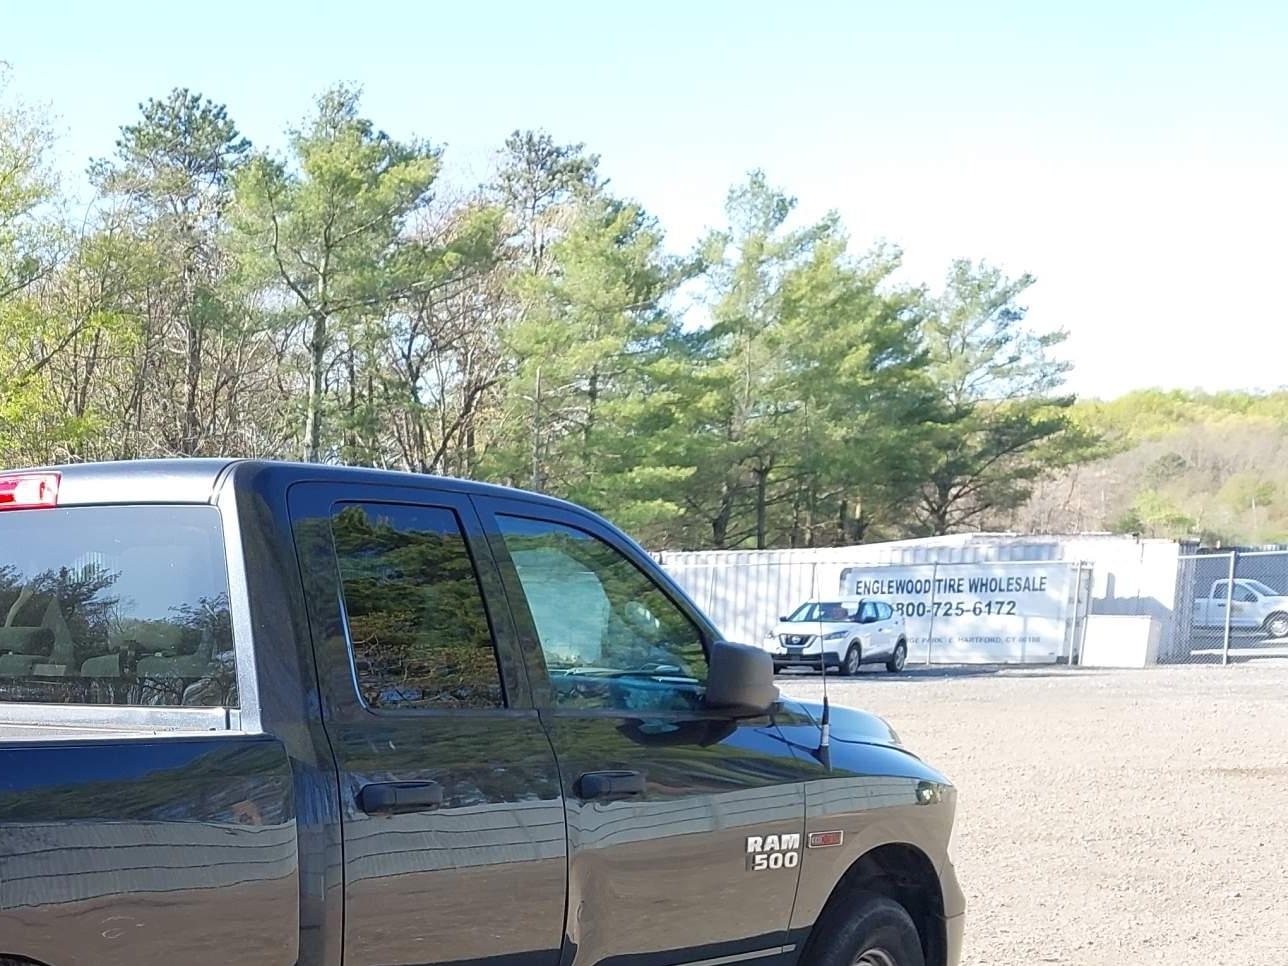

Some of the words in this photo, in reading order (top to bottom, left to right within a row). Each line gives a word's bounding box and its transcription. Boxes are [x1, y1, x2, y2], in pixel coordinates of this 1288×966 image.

[855, 578, 931, 595] ENGLEWOOD
[935, 577, 964, 593] TIRE
[968, 576, 1047, 593] WHOLESALE
[746, 833, 801, 853] RAM
